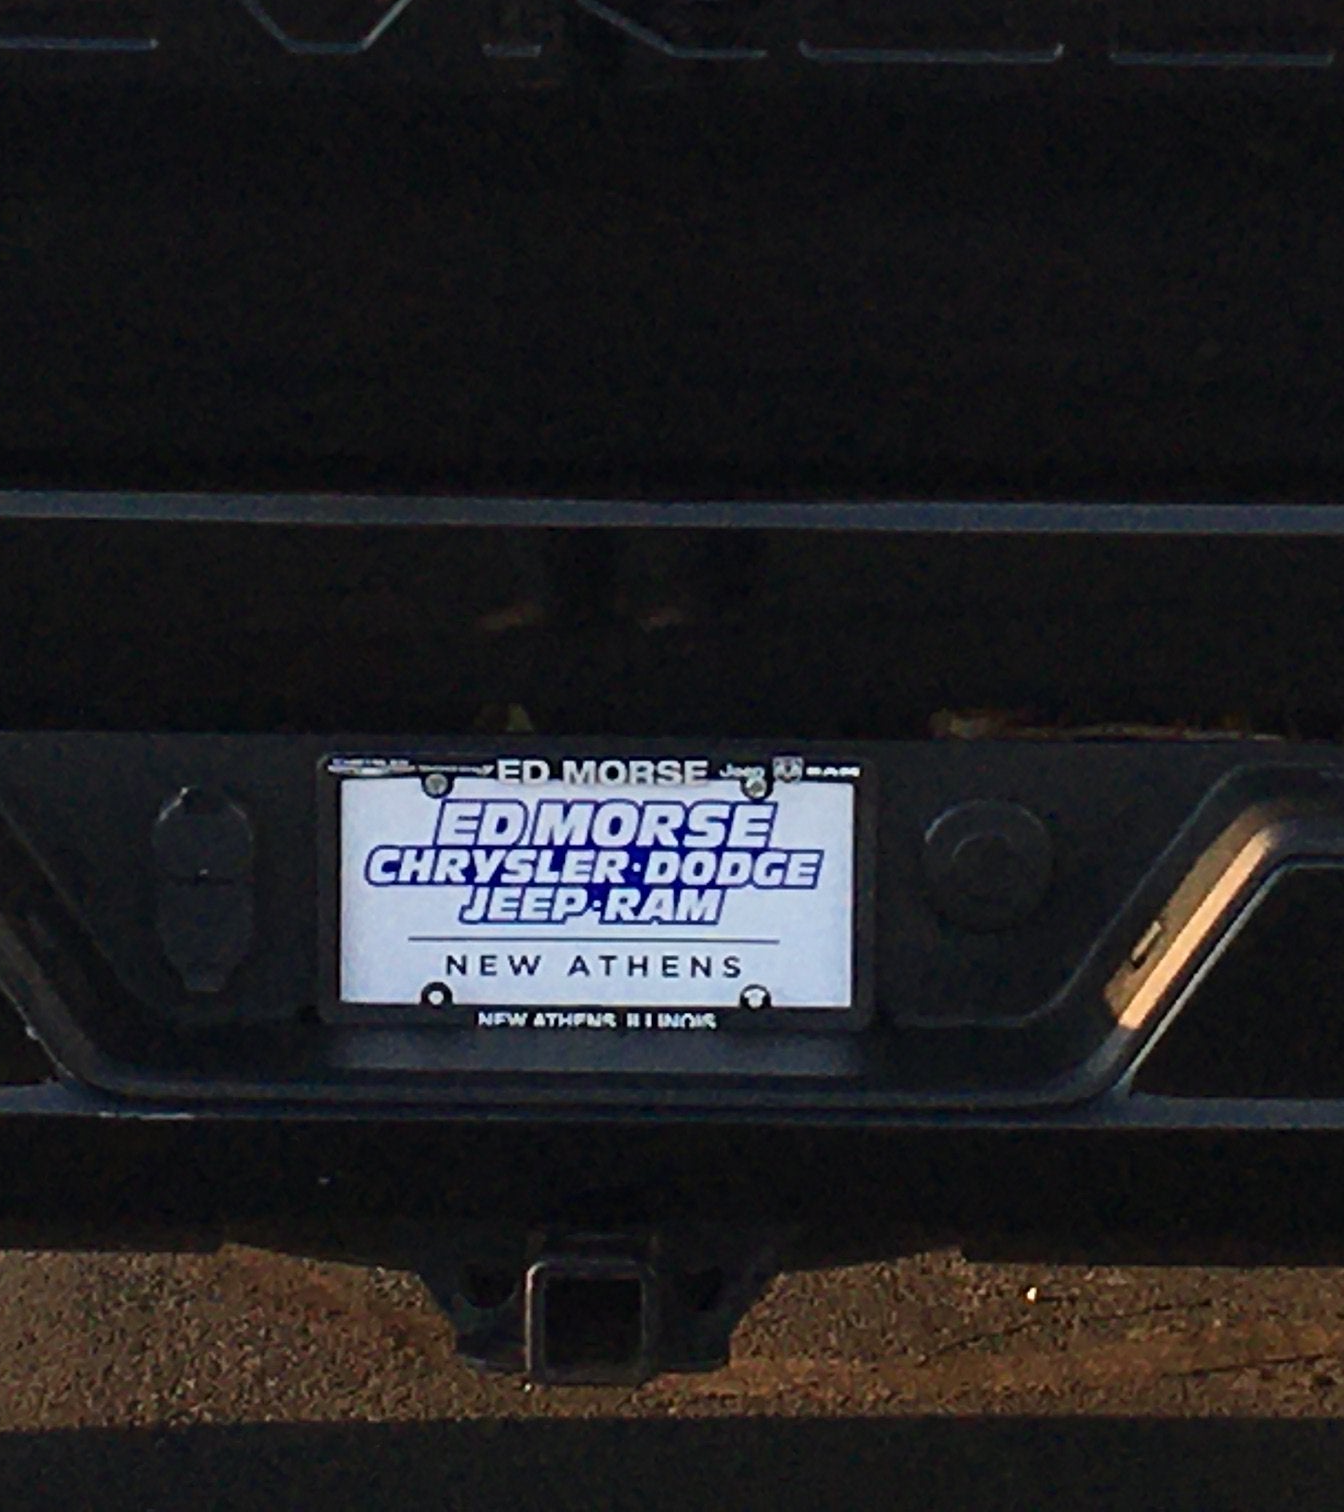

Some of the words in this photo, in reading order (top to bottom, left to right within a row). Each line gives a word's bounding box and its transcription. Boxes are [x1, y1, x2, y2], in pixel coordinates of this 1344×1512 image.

[496, 760, 552, 784] ED
[563, 760, 709, 787] MORSE
[437, 800, 528, 847] ED
[526, 800, 778, 849] MORSE
[365, 846, 631, 887] CHRYSLER
[642, 849, 823, 889] DODGE
[459, 886, 590, 924] JEEP
[598, 887, 726, 925] RAM
[445, 954, 542, 977] NEW
[568, 955, 744, 979] ATHENS
[477, 1011, 529, 1027] NEW
[532, 1012, 618, 1029] ATHENS
